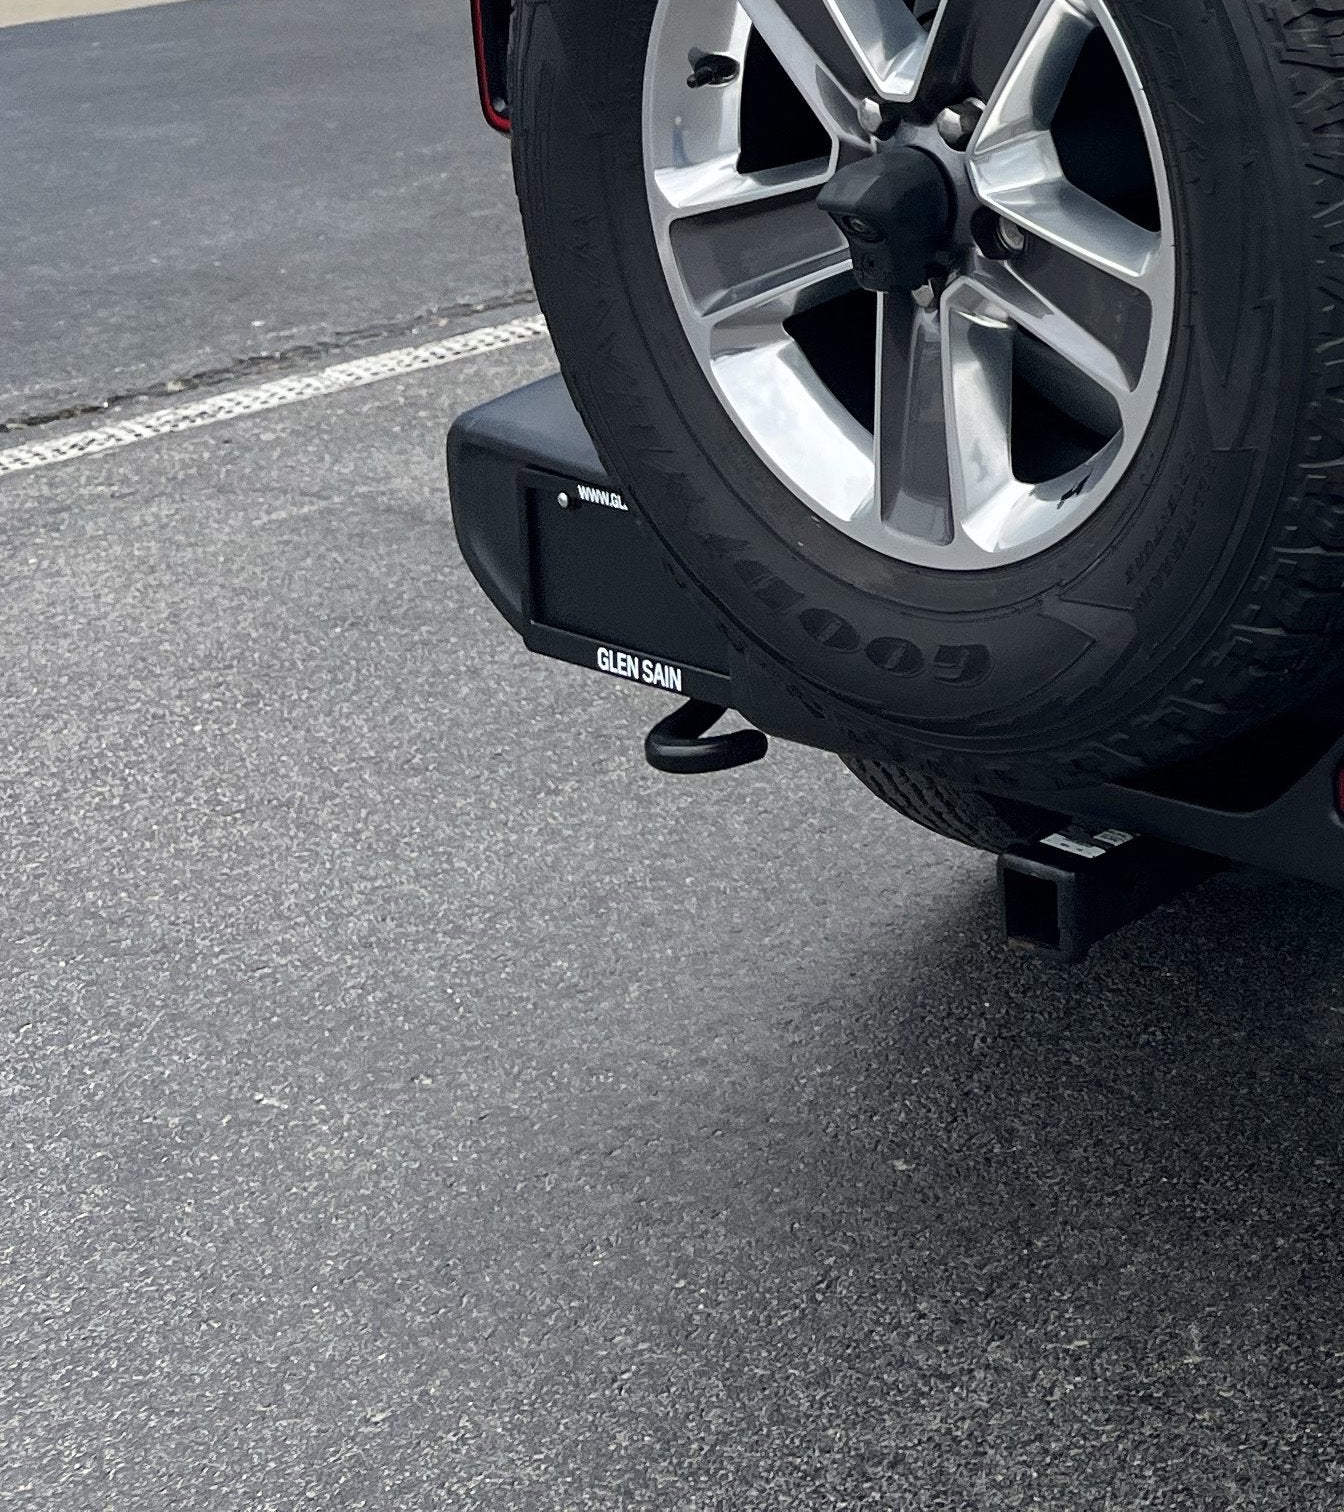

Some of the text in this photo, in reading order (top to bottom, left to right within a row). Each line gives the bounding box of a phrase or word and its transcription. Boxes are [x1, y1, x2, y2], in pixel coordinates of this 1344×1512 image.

[577, 484, 629, 511] WWW.GL
[597, 647, 682, 692] GLEN SAIN
